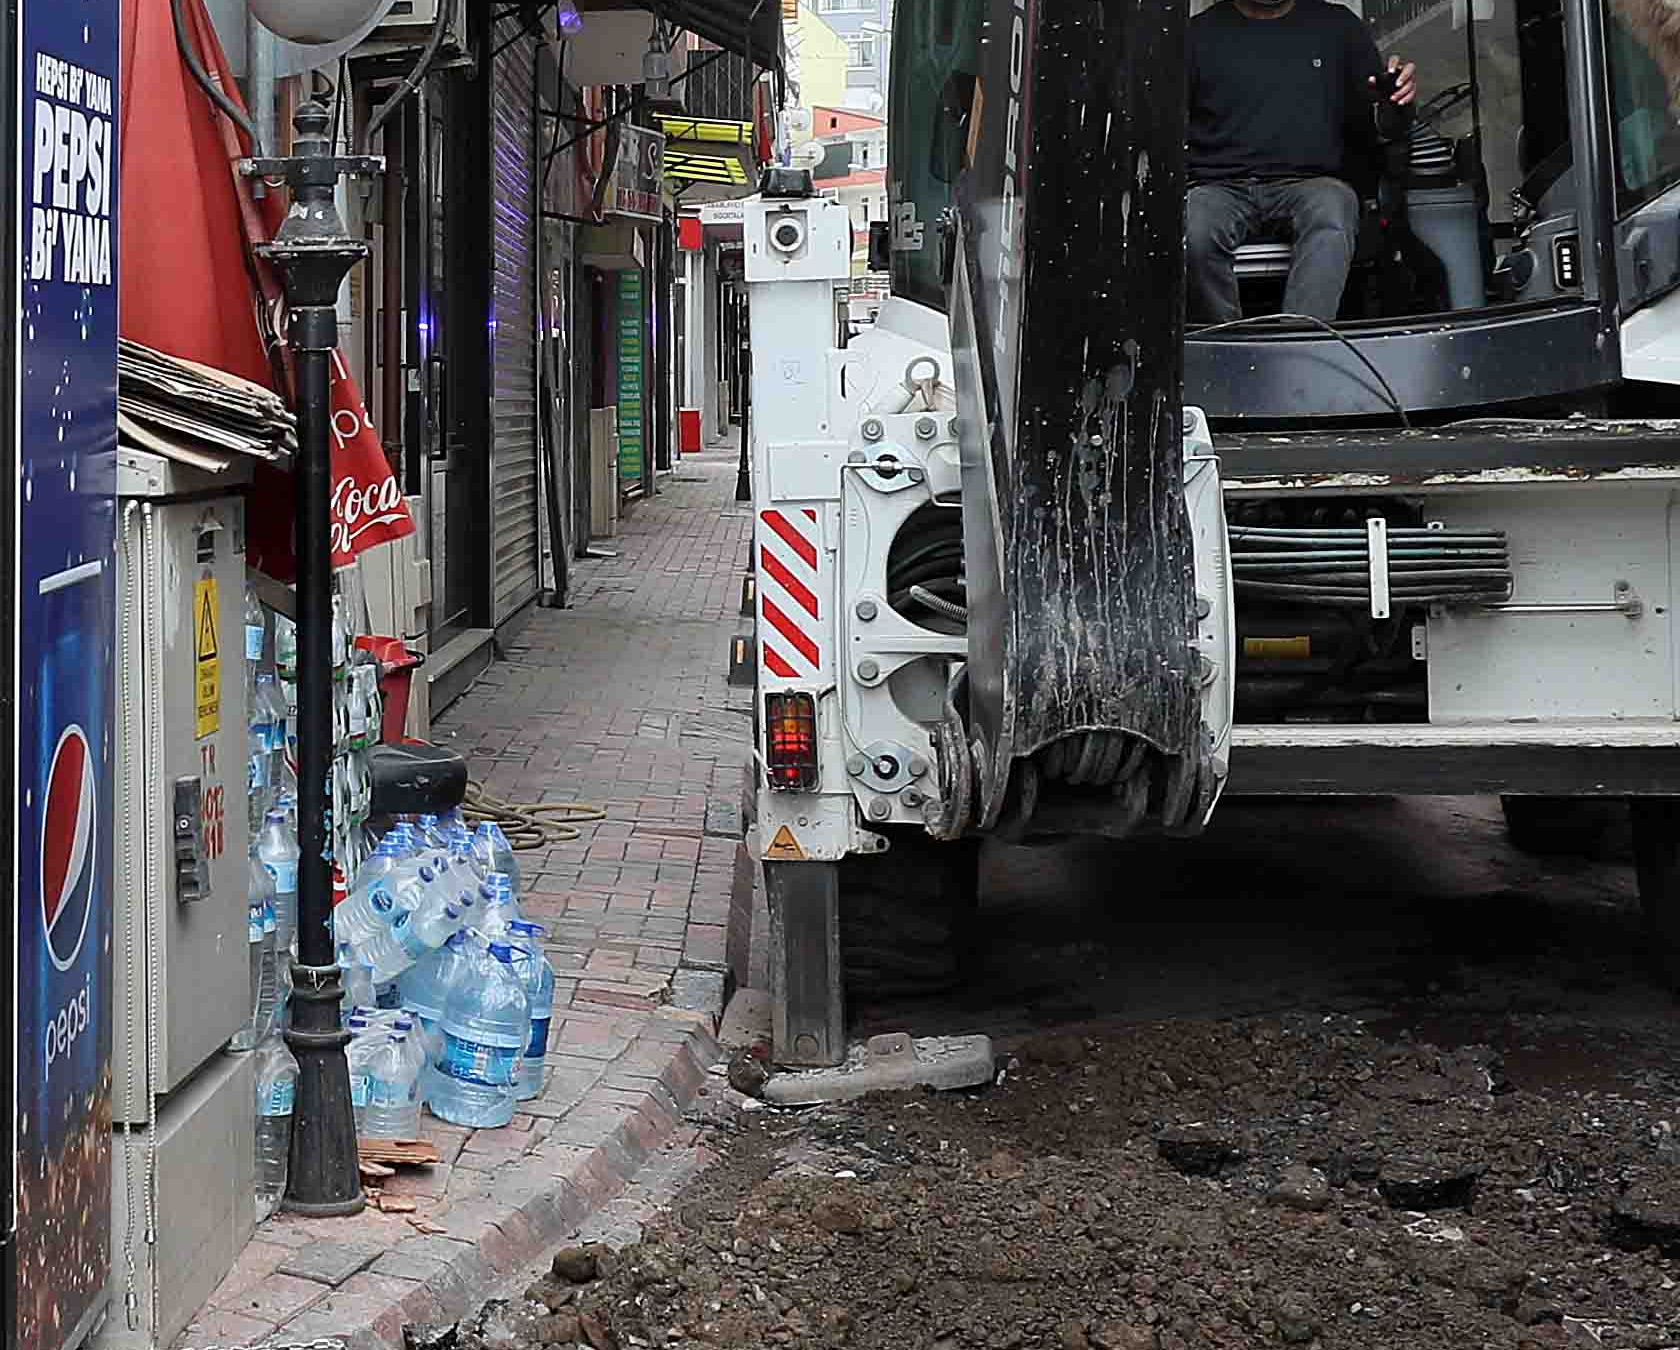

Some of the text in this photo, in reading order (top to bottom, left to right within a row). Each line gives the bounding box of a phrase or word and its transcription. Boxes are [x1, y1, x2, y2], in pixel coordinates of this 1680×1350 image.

[85, 70, 112, 116] YANA
[33, 98, 112, 217] PEPSI
[61, 212, 112, 285] YANA
[45, 971, 90, 1083] pepsi
